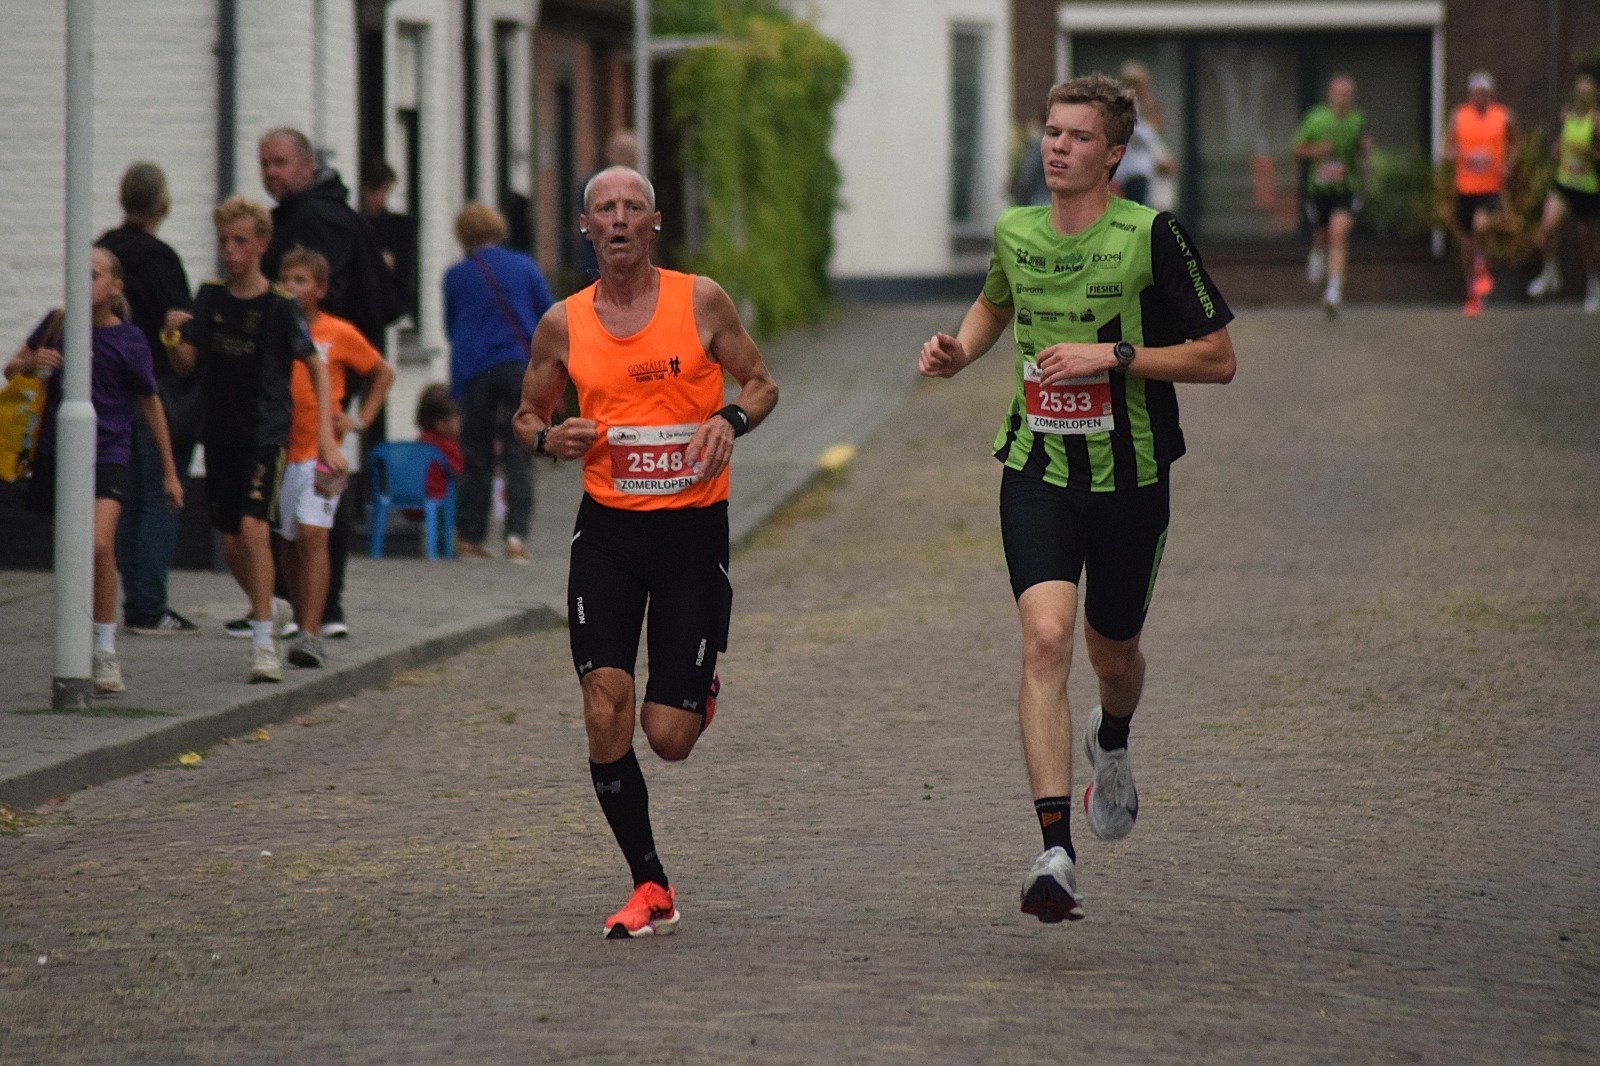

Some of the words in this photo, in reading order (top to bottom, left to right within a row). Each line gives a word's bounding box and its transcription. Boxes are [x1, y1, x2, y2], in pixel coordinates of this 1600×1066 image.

[1167, 219, 1192, 258] LUCKY
[1186, 259, 1216, 319] RUNNERS
[1089, 285, 1120, 294] FIESIEK
[627, 360, 667, 375] GONZÁLEZ
[1039, 390, 1092, 412] 2533
[1034, 417, 1101, 429] ZOMERLOPEN
[627, 451, 683, 473] 2548
[621, 478, 693, 490] ZOMERLOPEN
[576, 596, 586, 624] FUSION
[695, 638, 708, 667] FUSION
